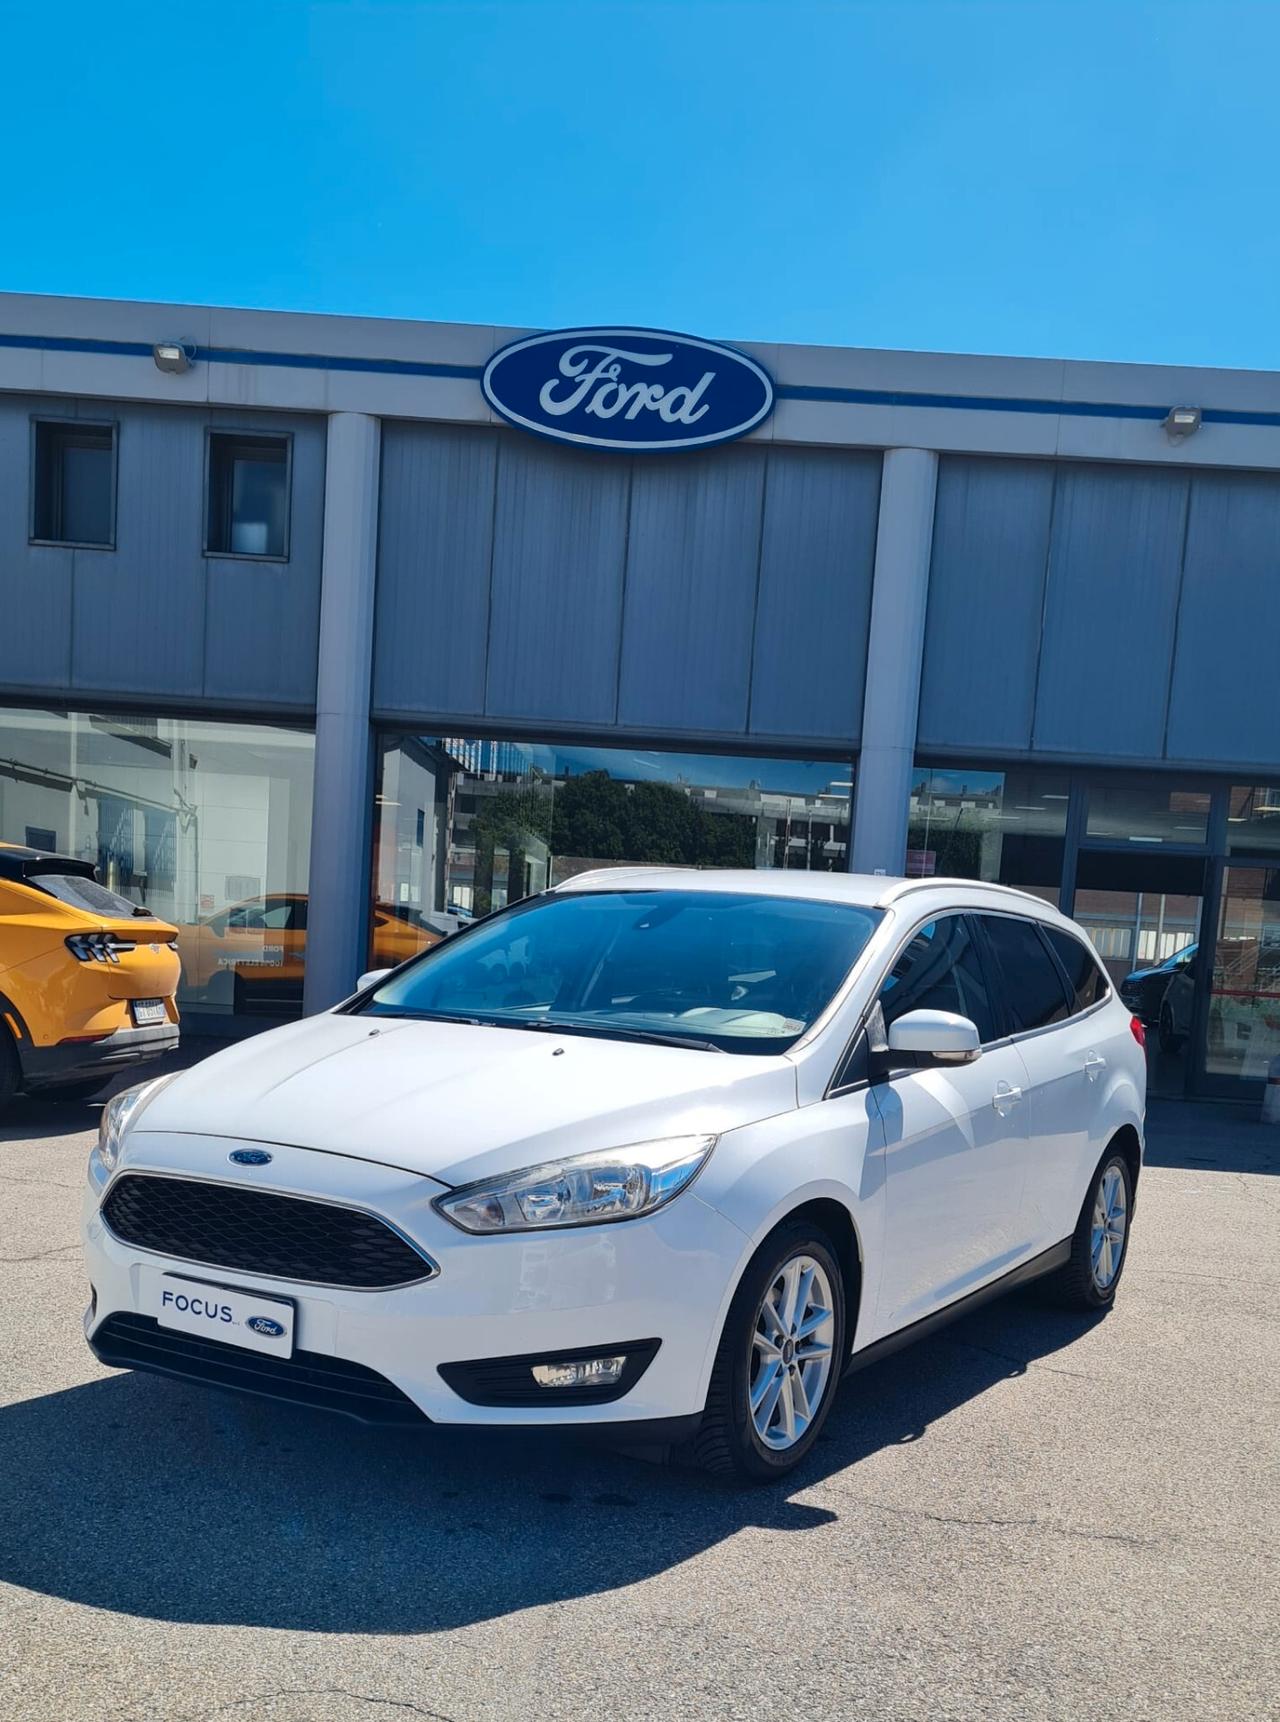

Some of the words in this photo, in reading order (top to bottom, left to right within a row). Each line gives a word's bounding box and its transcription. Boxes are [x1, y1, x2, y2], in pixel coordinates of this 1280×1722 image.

[539, 345, 716, 424] Ford
[162, 1290, 233, 1323] FOCUS
[254, 1319, 278, 1335] Ford
